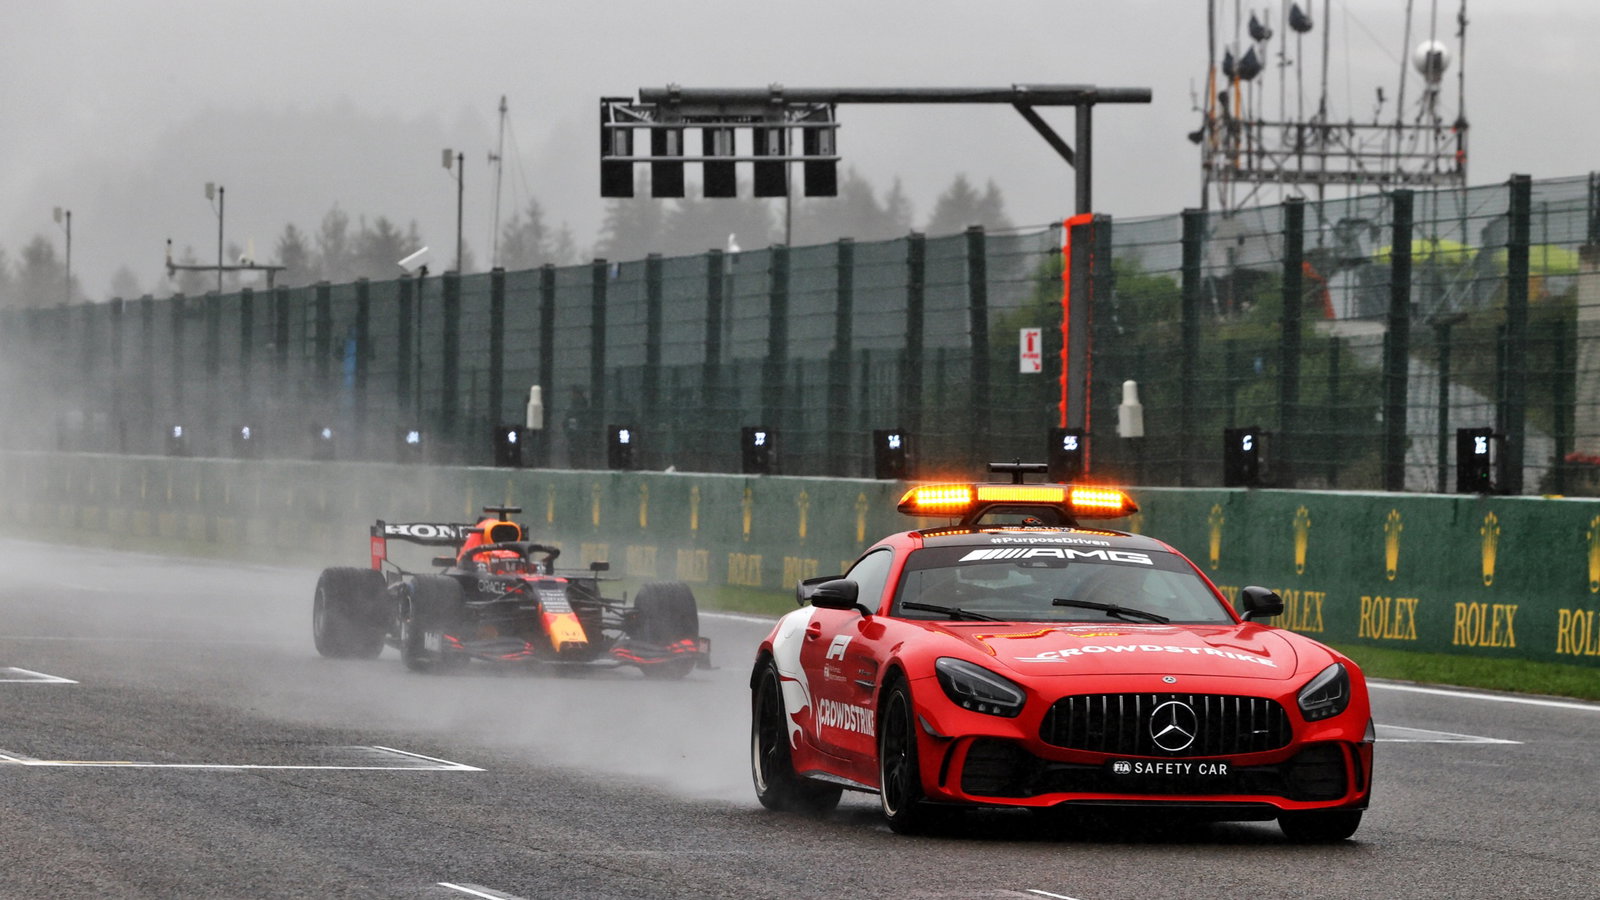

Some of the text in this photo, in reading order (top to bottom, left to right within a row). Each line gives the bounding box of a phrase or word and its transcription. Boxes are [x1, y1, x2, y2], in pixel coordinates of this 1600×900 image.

[991, 537, 1110, 547] #PurposeDriven
[1022, 549, 1153, 565] AMG
[478, 580, 506, 595] ORACLE
[1358, 596, 1419, 640] ROLEX
[1452, 602, 1519, 648] ROLEX
[1556, 608, 1600, 656] ROL
[1036, 644, 1279, 668] CROWDSTRIKE
[819, 697, 876, 737] CROWDSTRIKE
[1113, 762, 1228, 776] FIA SAFETY CAR
